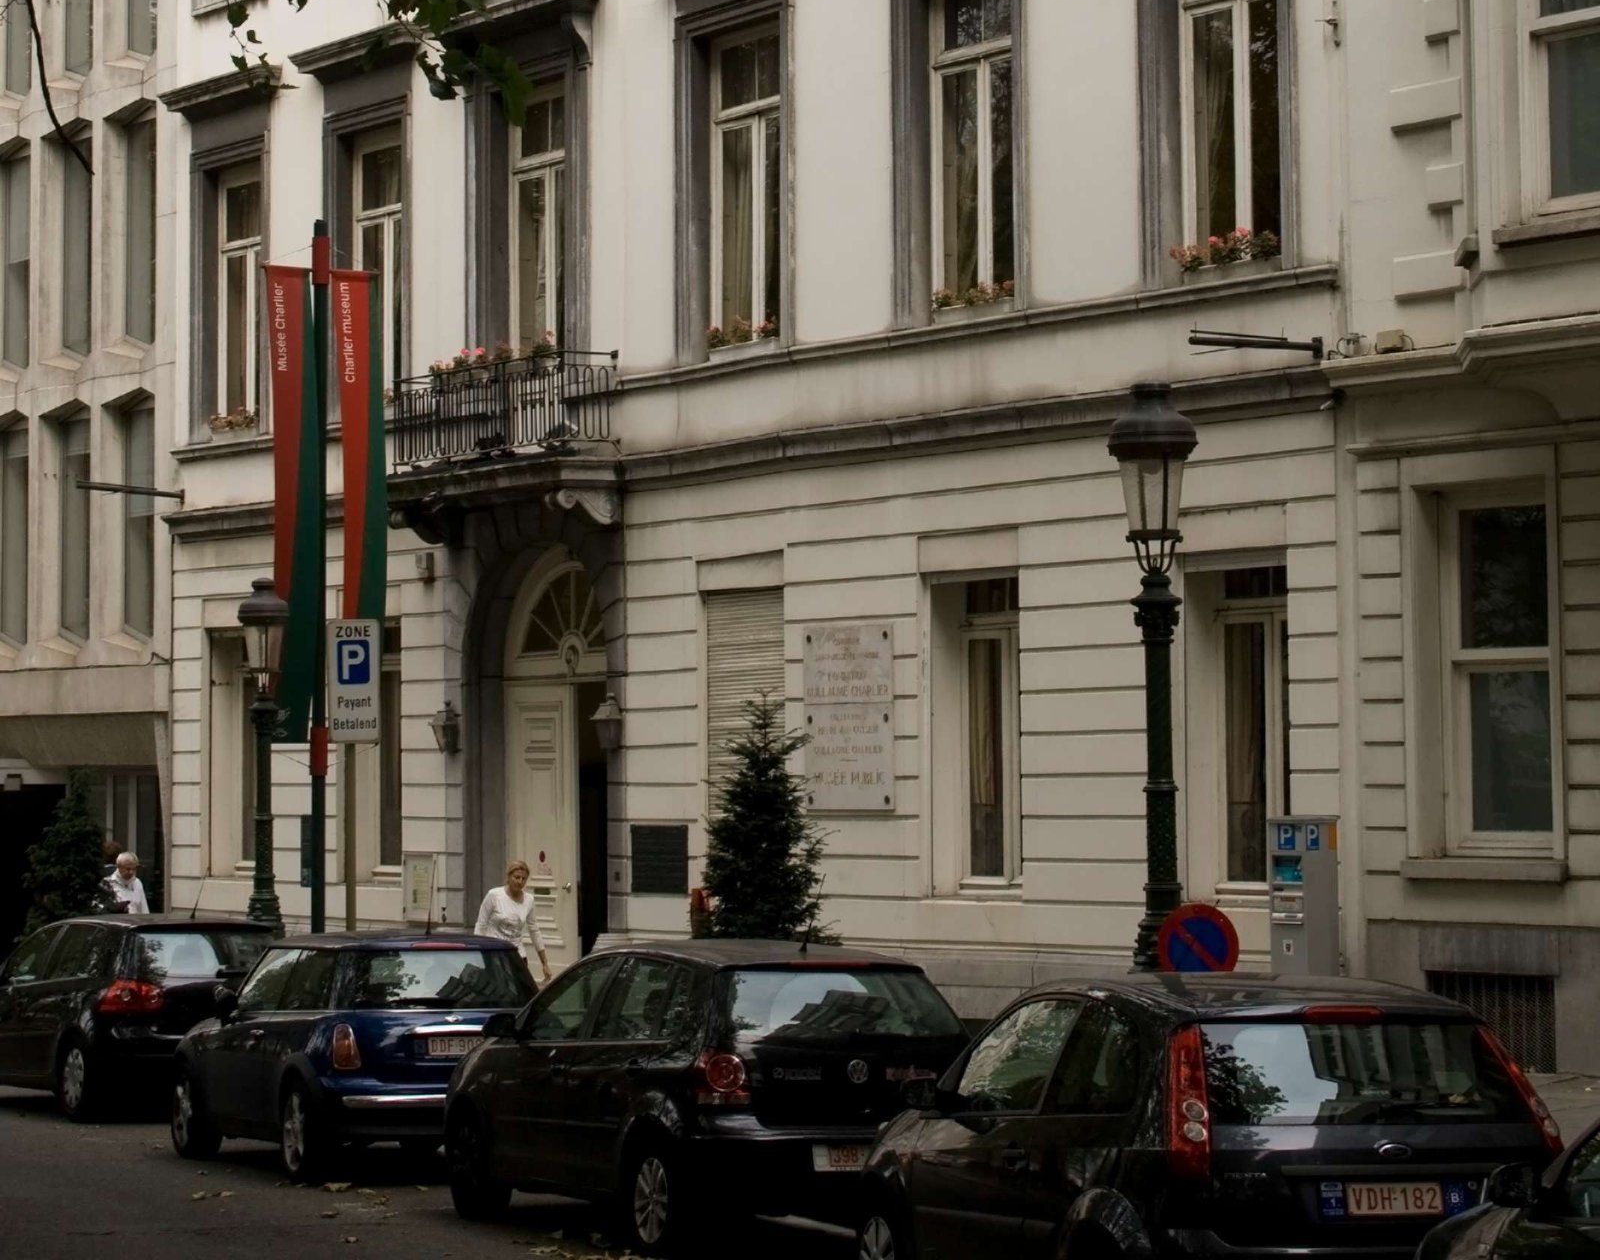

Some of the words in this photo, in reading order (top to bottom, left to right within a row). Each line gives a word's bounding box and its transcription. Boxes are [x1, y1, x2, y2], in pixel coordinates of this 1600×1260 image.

[273, 282, 286, 330] Charlier
[340, 282, 353, 334] museum
[276, 331, 288, 372] Musée
[343, 336, 356, 383] Charlier
[335, 625, 372, 638] ZONE
[342, 644, 366, 680] P
[337, 695, 372, 711] Payant
[333, 716, 377, 731] Betalend
[1280, 826, 1292, 845] P
[1307, 825, 1318, 845] P
[1352, 1187, 1439, 1211] VDH-182
